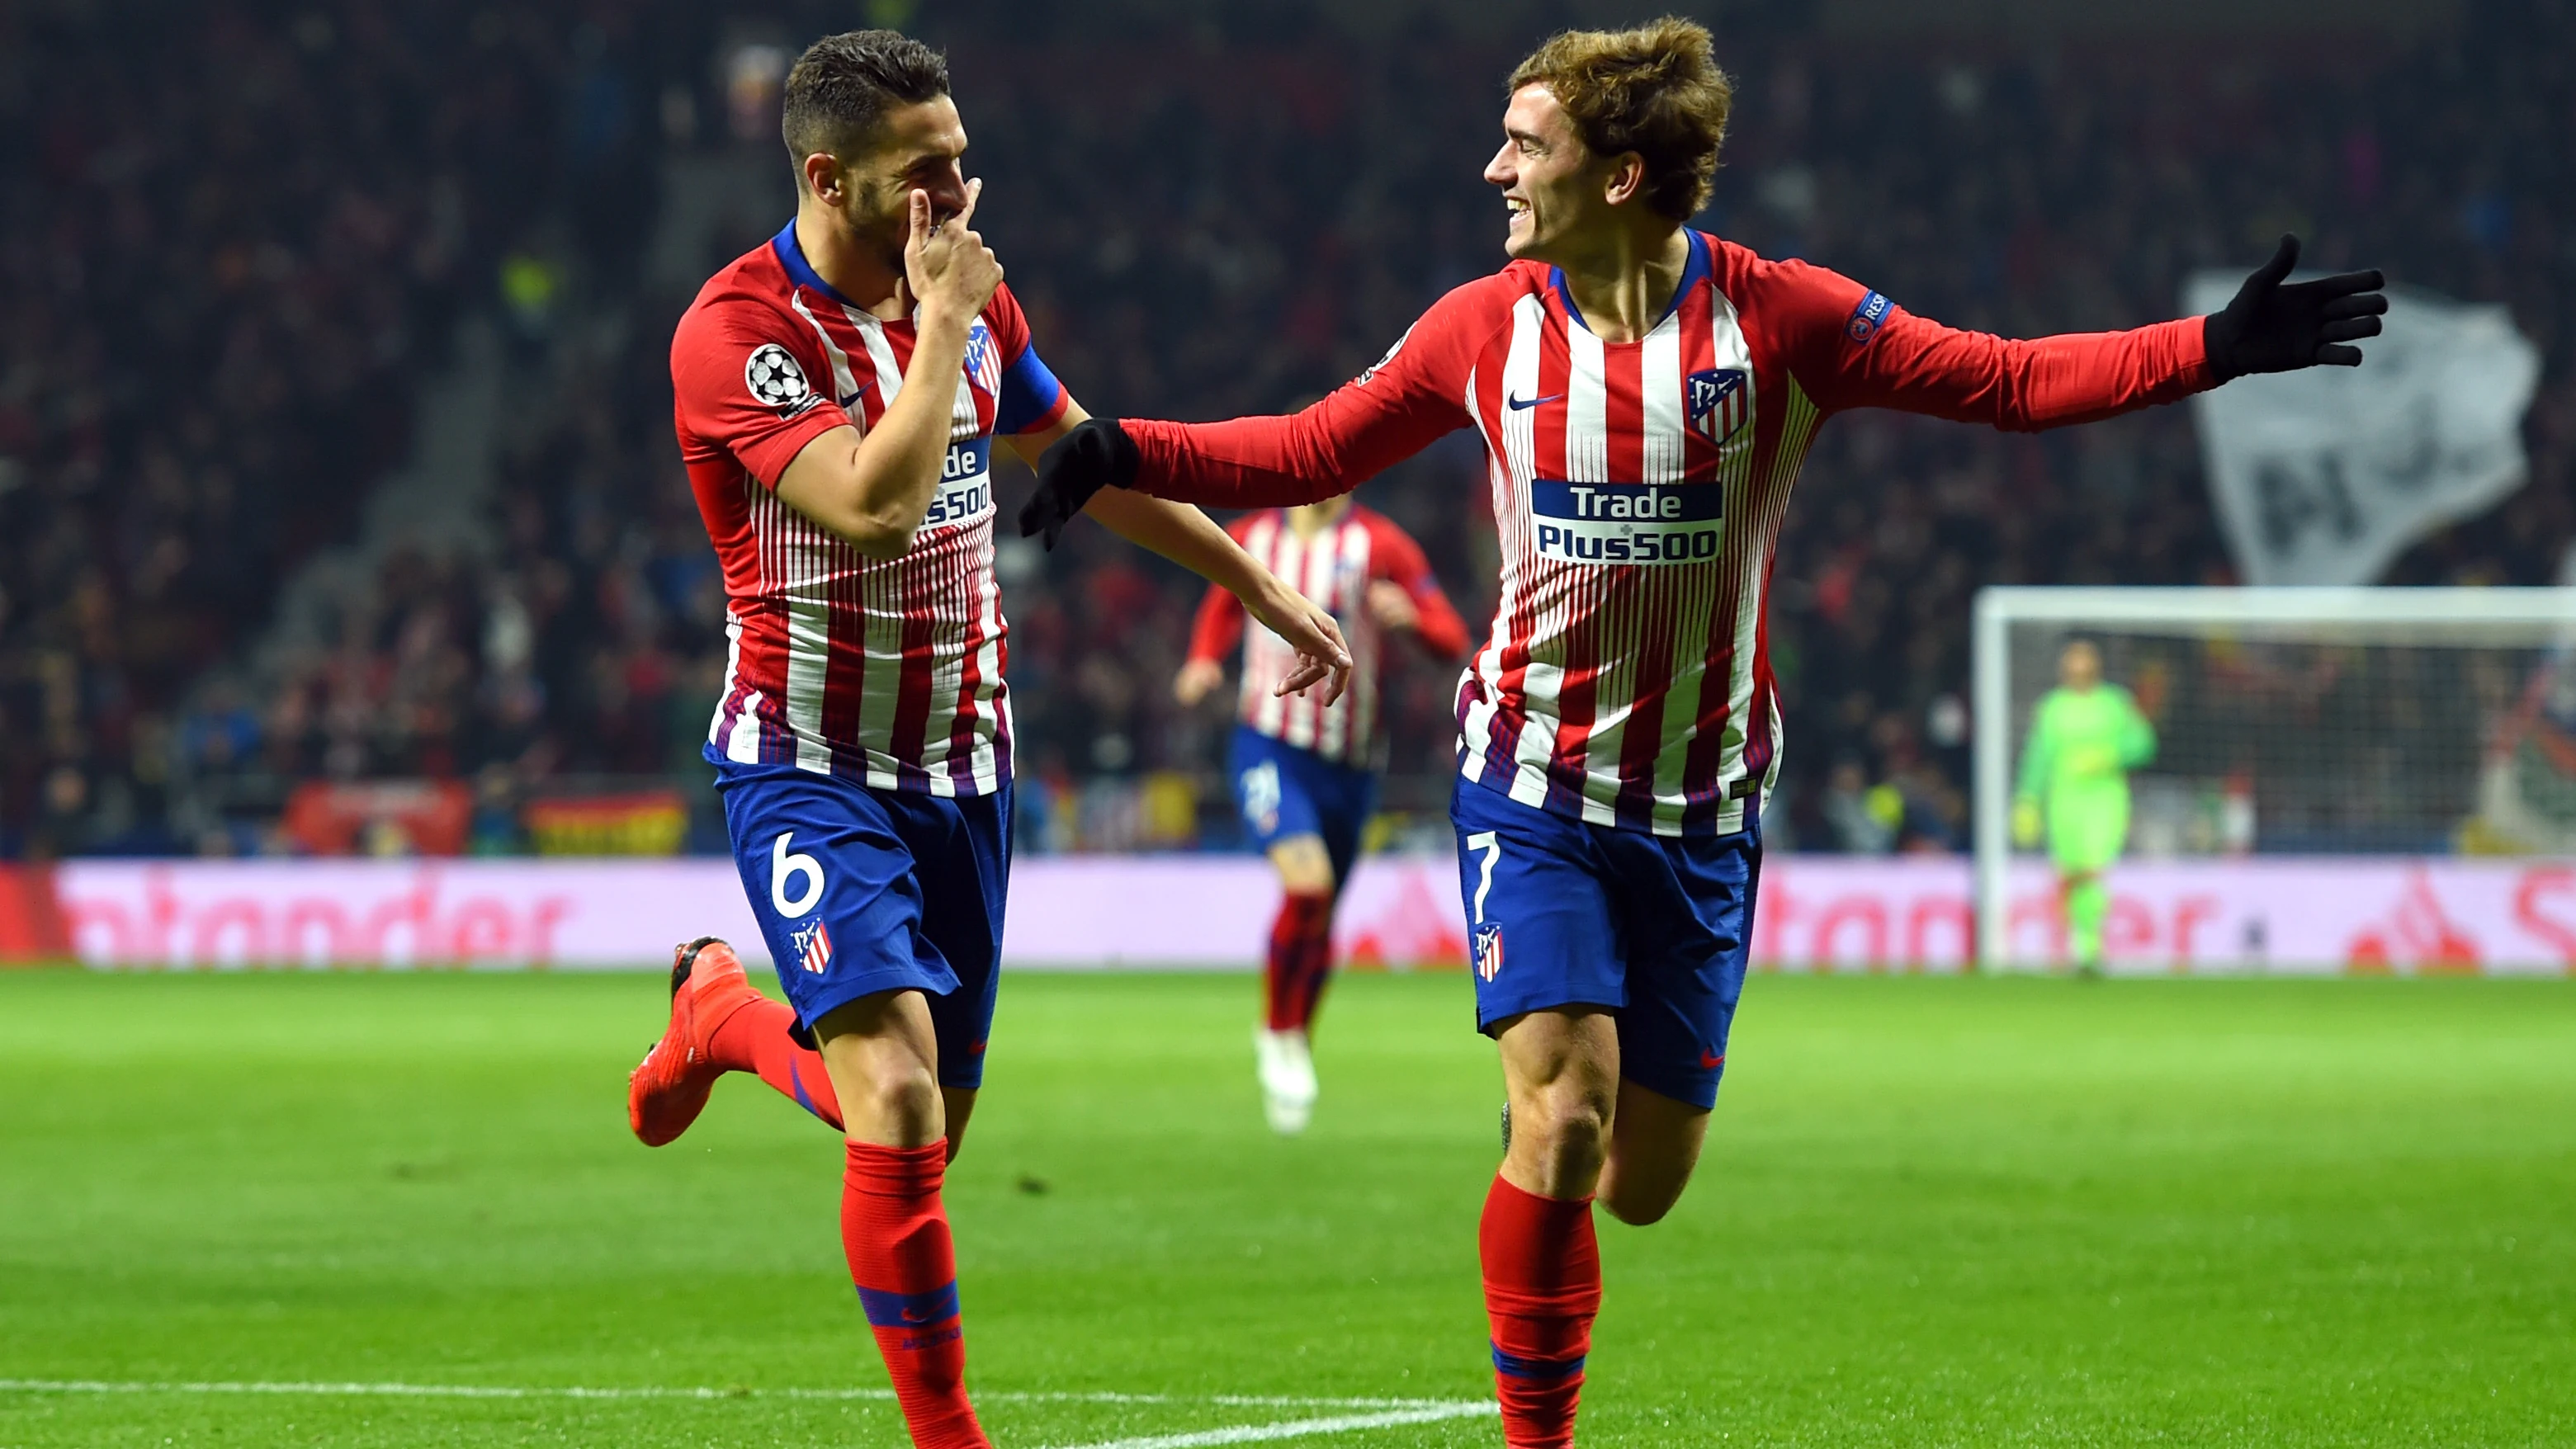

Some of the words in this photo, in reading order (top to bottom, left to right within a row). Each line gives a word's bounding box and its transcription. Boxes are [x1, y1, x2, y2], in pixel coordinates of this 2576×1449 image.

[943, 445, 976, 479] de
[926, 482, 988, 524] s500
[1570, 487, 1681, 518] Trade
[1538, 524, 1718, 560] Plus500
[772, 832, 825, 918] 6
[1467, 831, 1501, 924] 7
